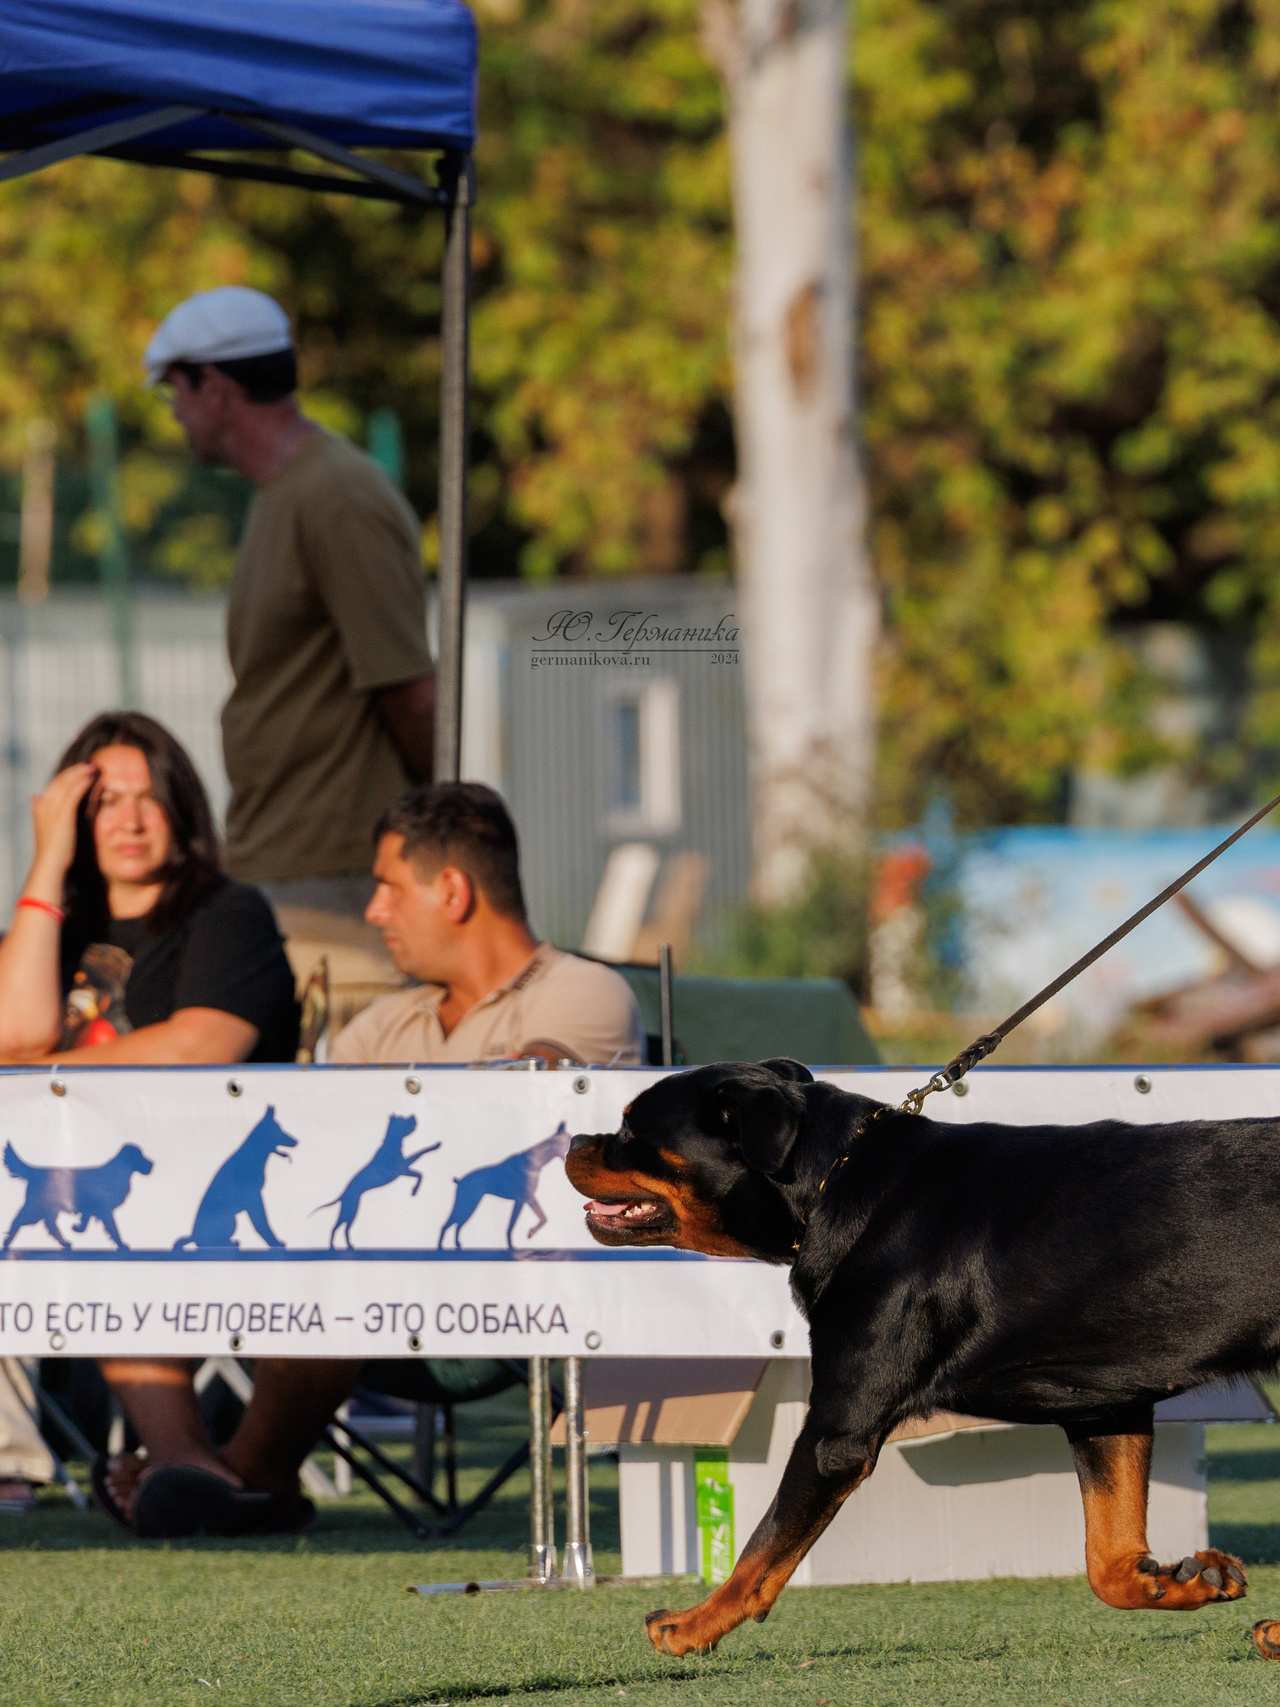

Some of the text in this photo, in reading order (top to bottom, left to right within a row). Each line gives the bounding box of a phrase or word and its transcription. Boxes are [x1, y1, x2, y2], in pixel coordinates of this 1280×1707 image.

[46, 1303, 123, 1333] ЕСТЬ
[132, 1303, 152, 1332] У
[162, 1303, 325, 1333] ЧЕЛОВЕКА
[364, 1302, 425, 1333] ЭТО
[436, 1303, 569, 1333] СОБАКА
